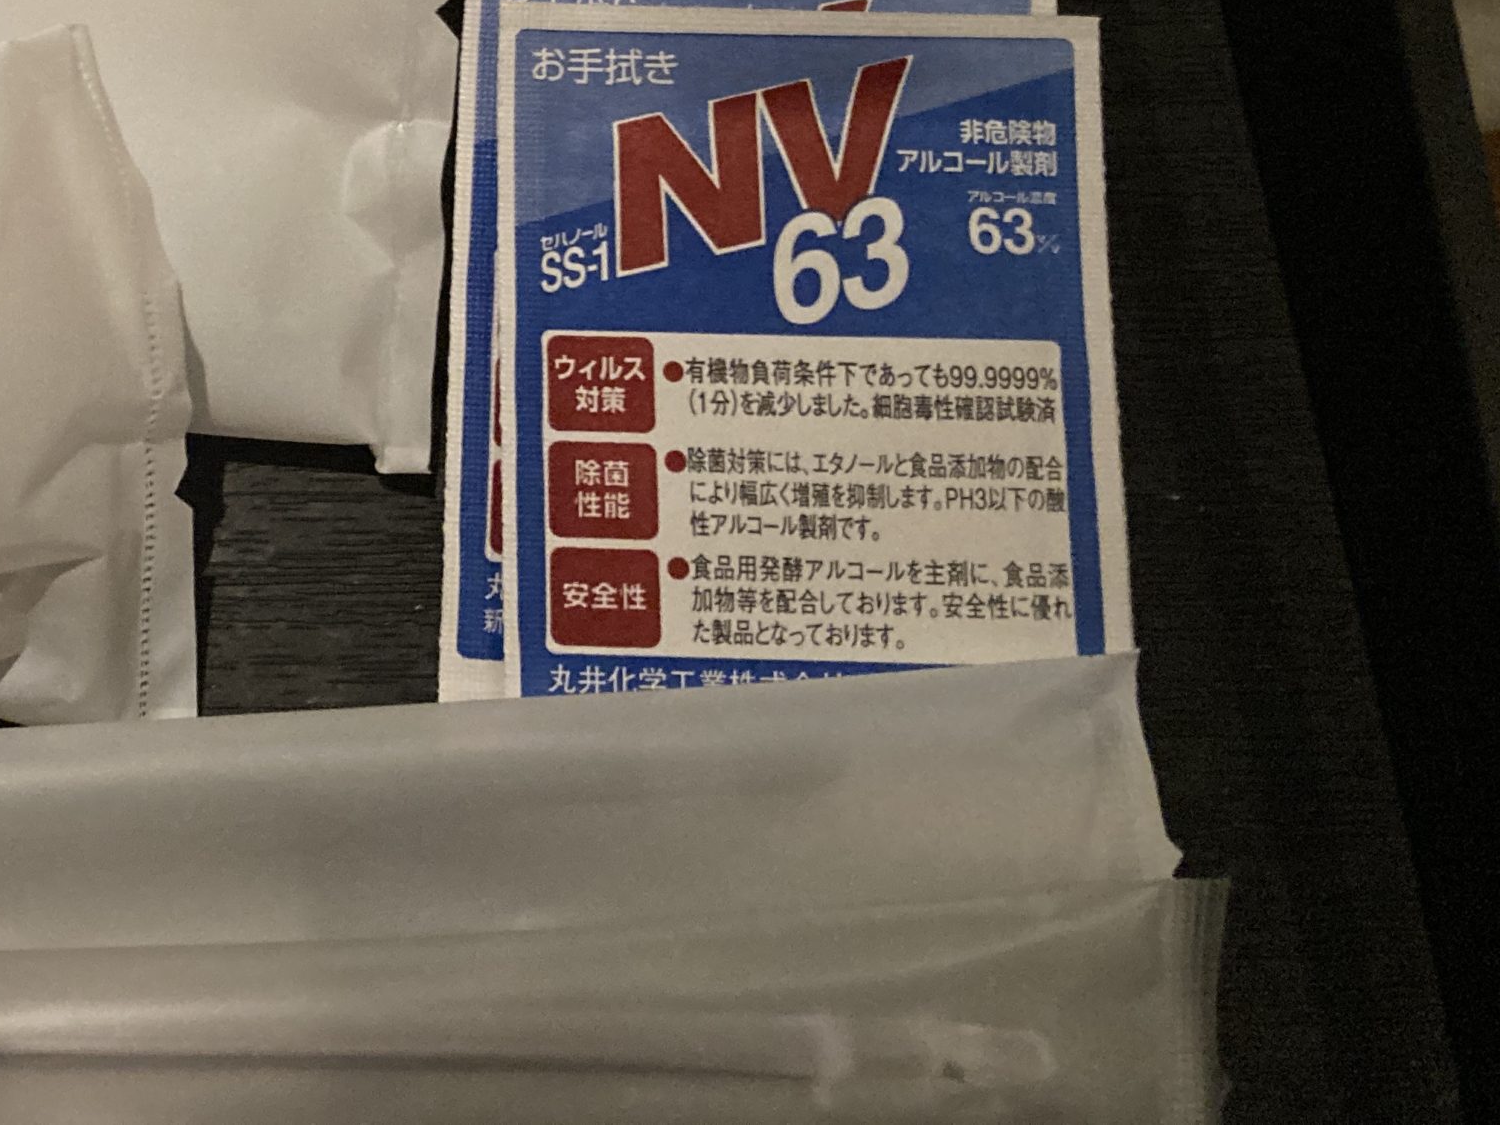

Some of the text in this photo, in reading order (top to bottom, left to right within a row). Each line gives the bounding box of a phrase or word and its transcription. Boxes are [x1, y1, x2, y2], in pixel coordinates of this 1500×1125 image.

[531, 48, 678, 85] お手拭き
[959, 119, 1057, 146] 非危険物
[612, 55, 913, 278] NV
[896, 149, 1058, 177] アルコール製剤
[541, 240, 609, 293] SS-1
[773, 196, 910, 326] 63
[554, 355, 646, 381] ウィルス
[575, 385, 627, 414] 対策
[575, 459, 629, 487] 除菌
[575, 491, 630, 519] 性能
[690, 510, 880, 542] 性アルコール製剤です。
[562, 581, 647, 611] 安全性
[693, 619, 905, 650] た製品となっております。
